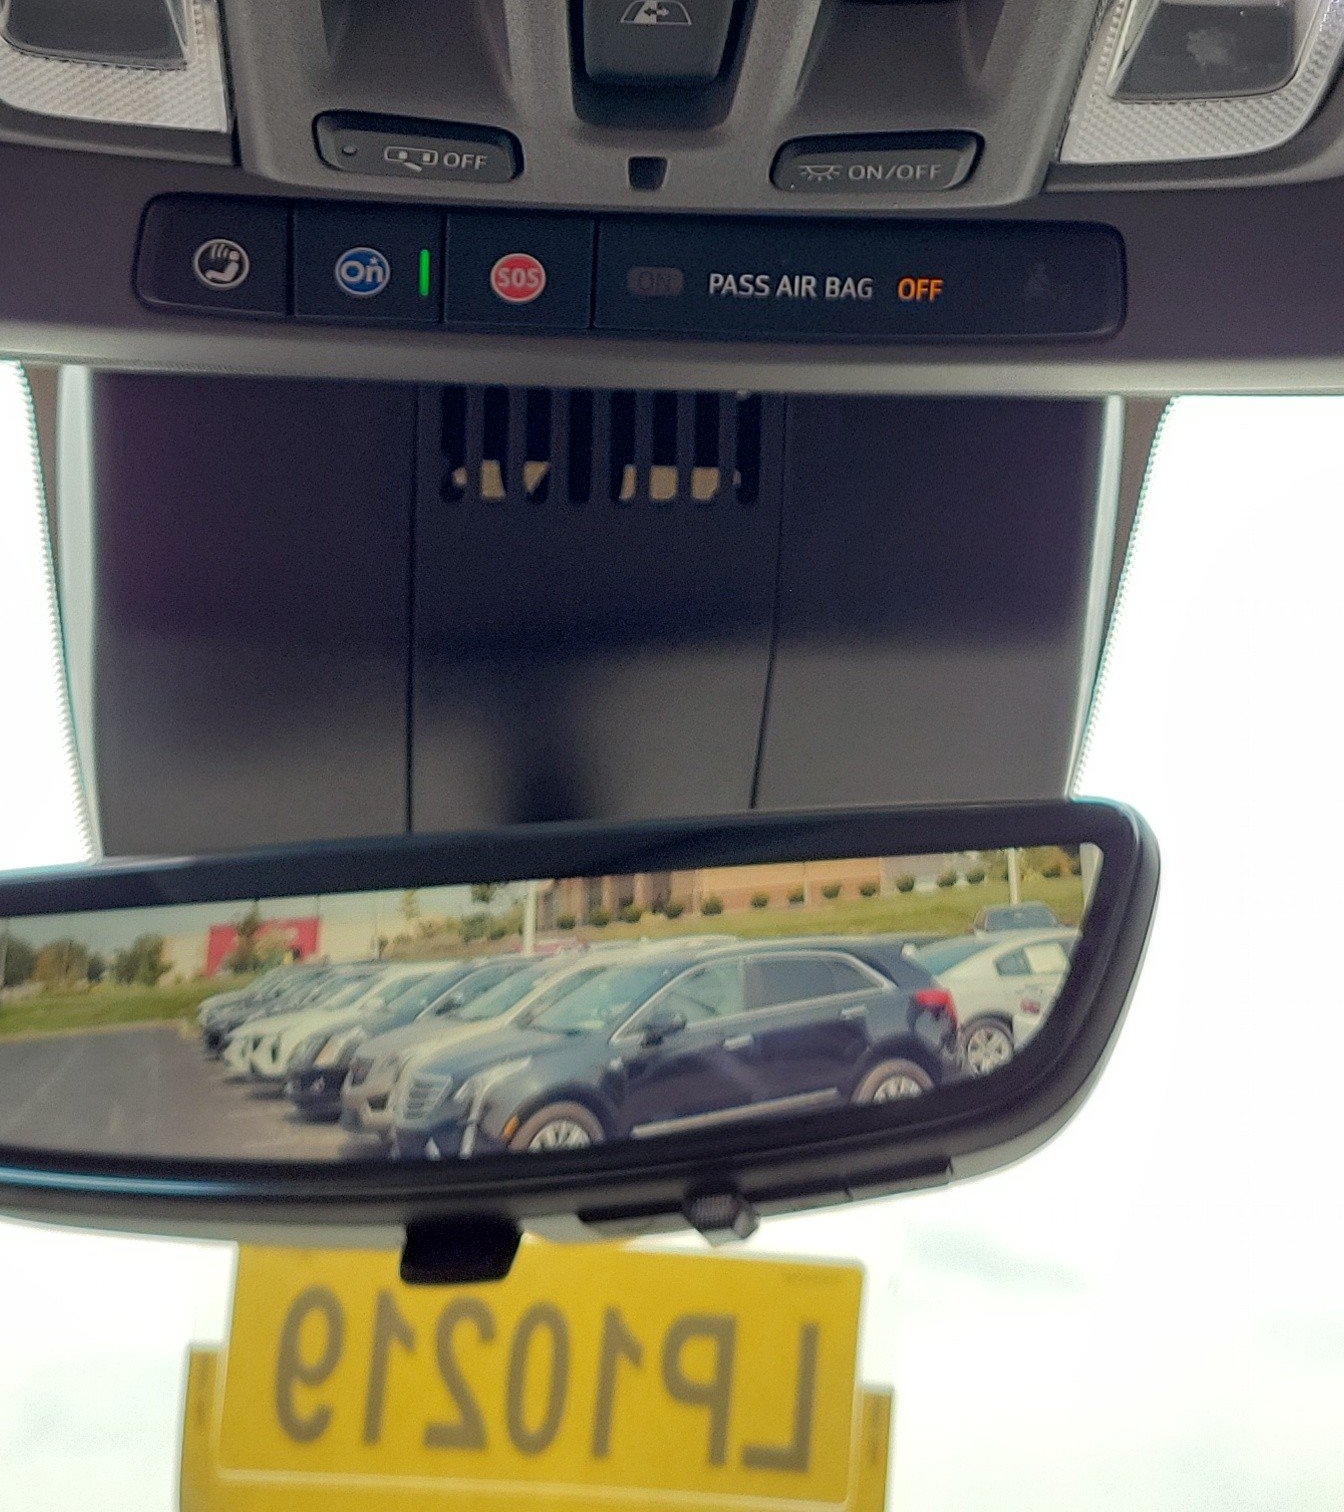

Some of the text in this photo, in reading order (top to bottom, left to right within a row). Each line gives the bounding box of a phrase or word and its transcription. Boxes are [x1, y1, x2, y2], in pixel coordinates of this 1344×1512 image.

[443, 152, 488, 170] OFF
[848, 164, 942, 181] ON/OFF
[340, 257, 384, 284] On
[497, 266, 540, 289] SOS
[708, 273, 944, 301] PASS AIR BAG OFF
